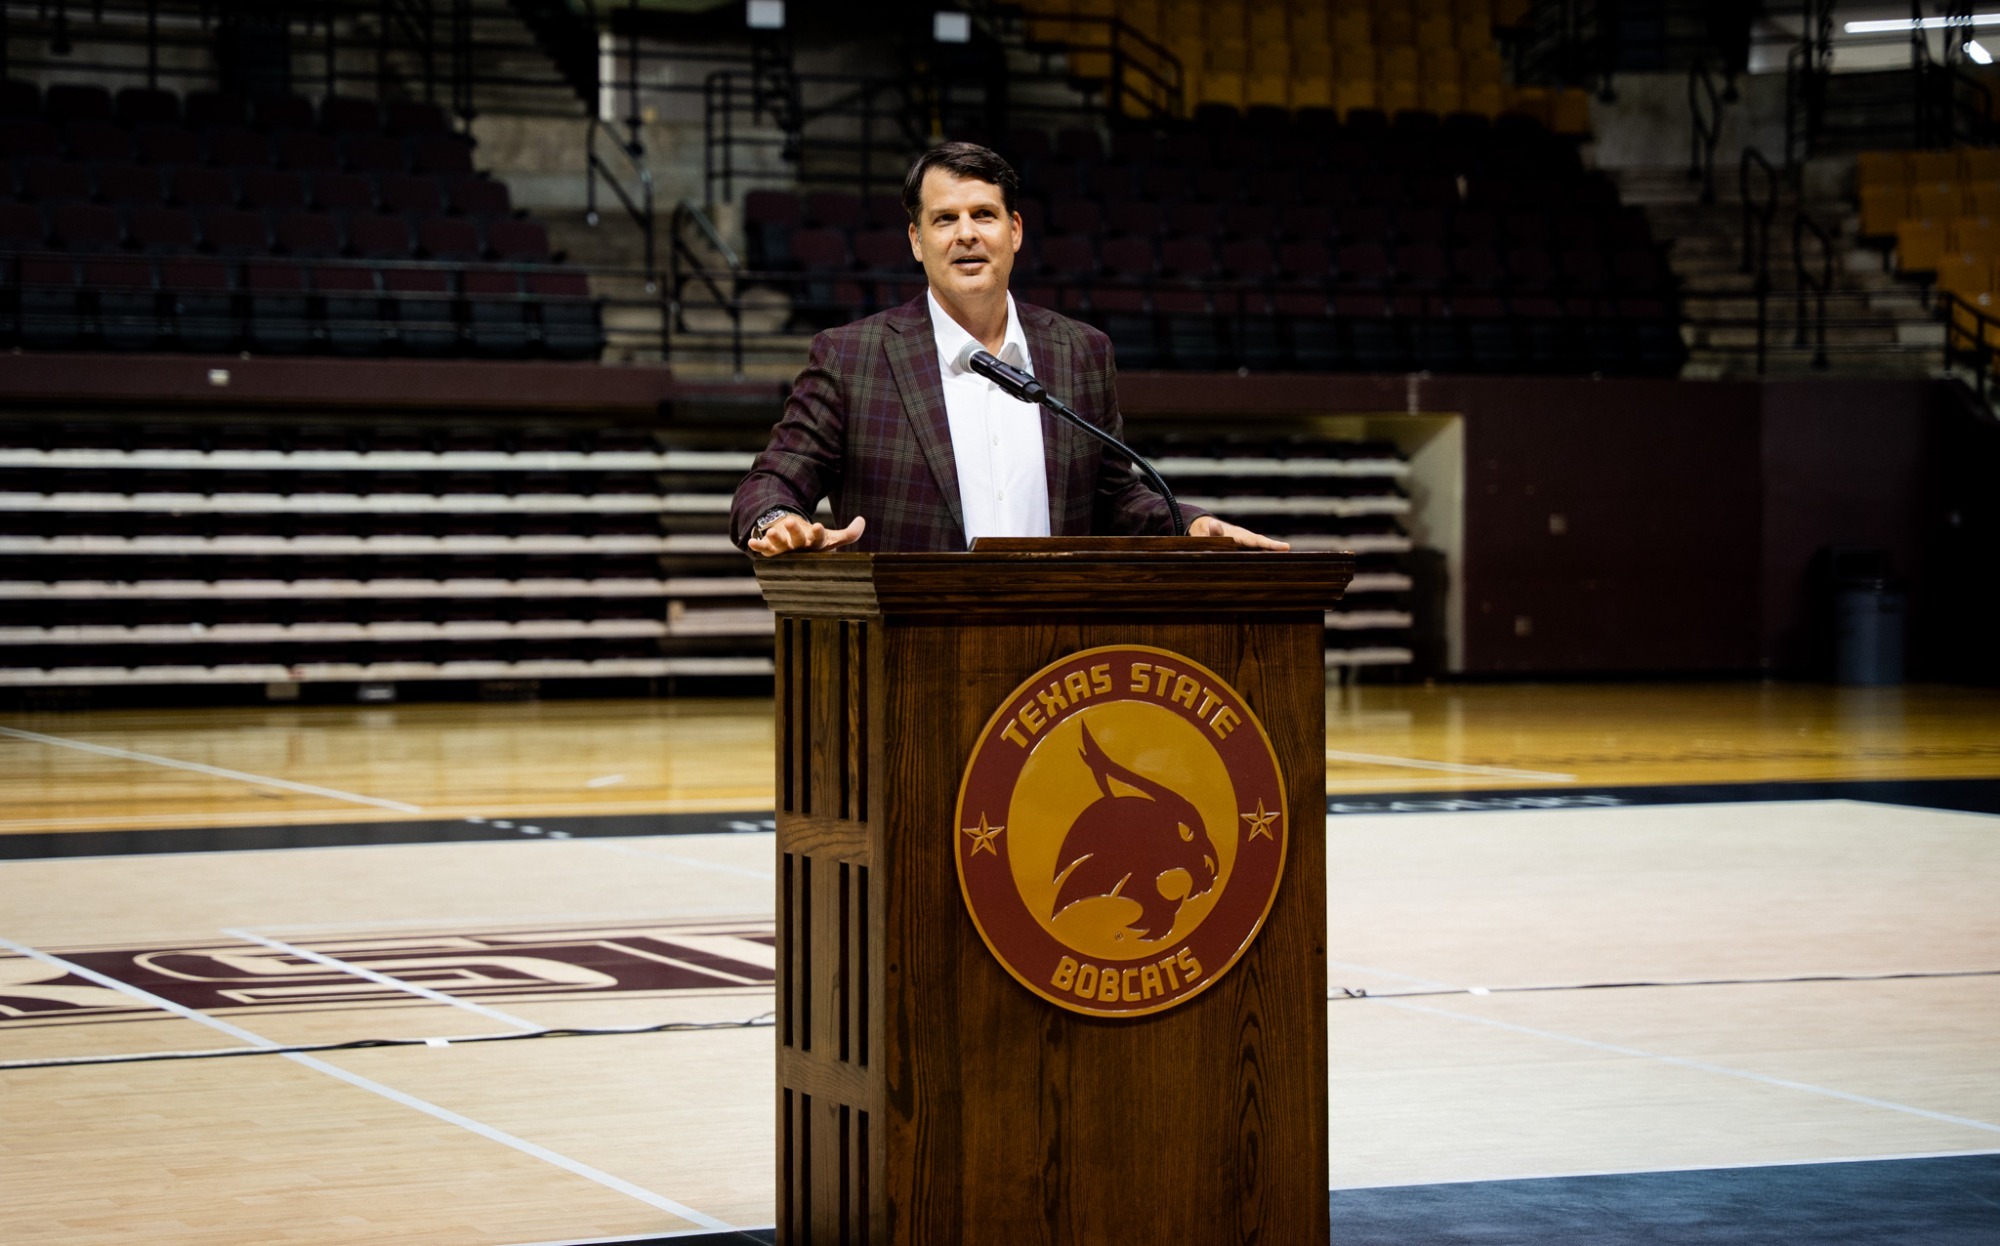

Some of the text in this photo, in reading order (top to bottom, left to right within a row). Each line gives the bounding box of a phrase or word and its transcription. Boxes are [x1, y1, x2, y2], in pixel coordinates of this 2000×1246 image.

[1000, 662, 1242, 748] TEXAS STATE
[1050, 946, 1203, 1002] BOBCATS
